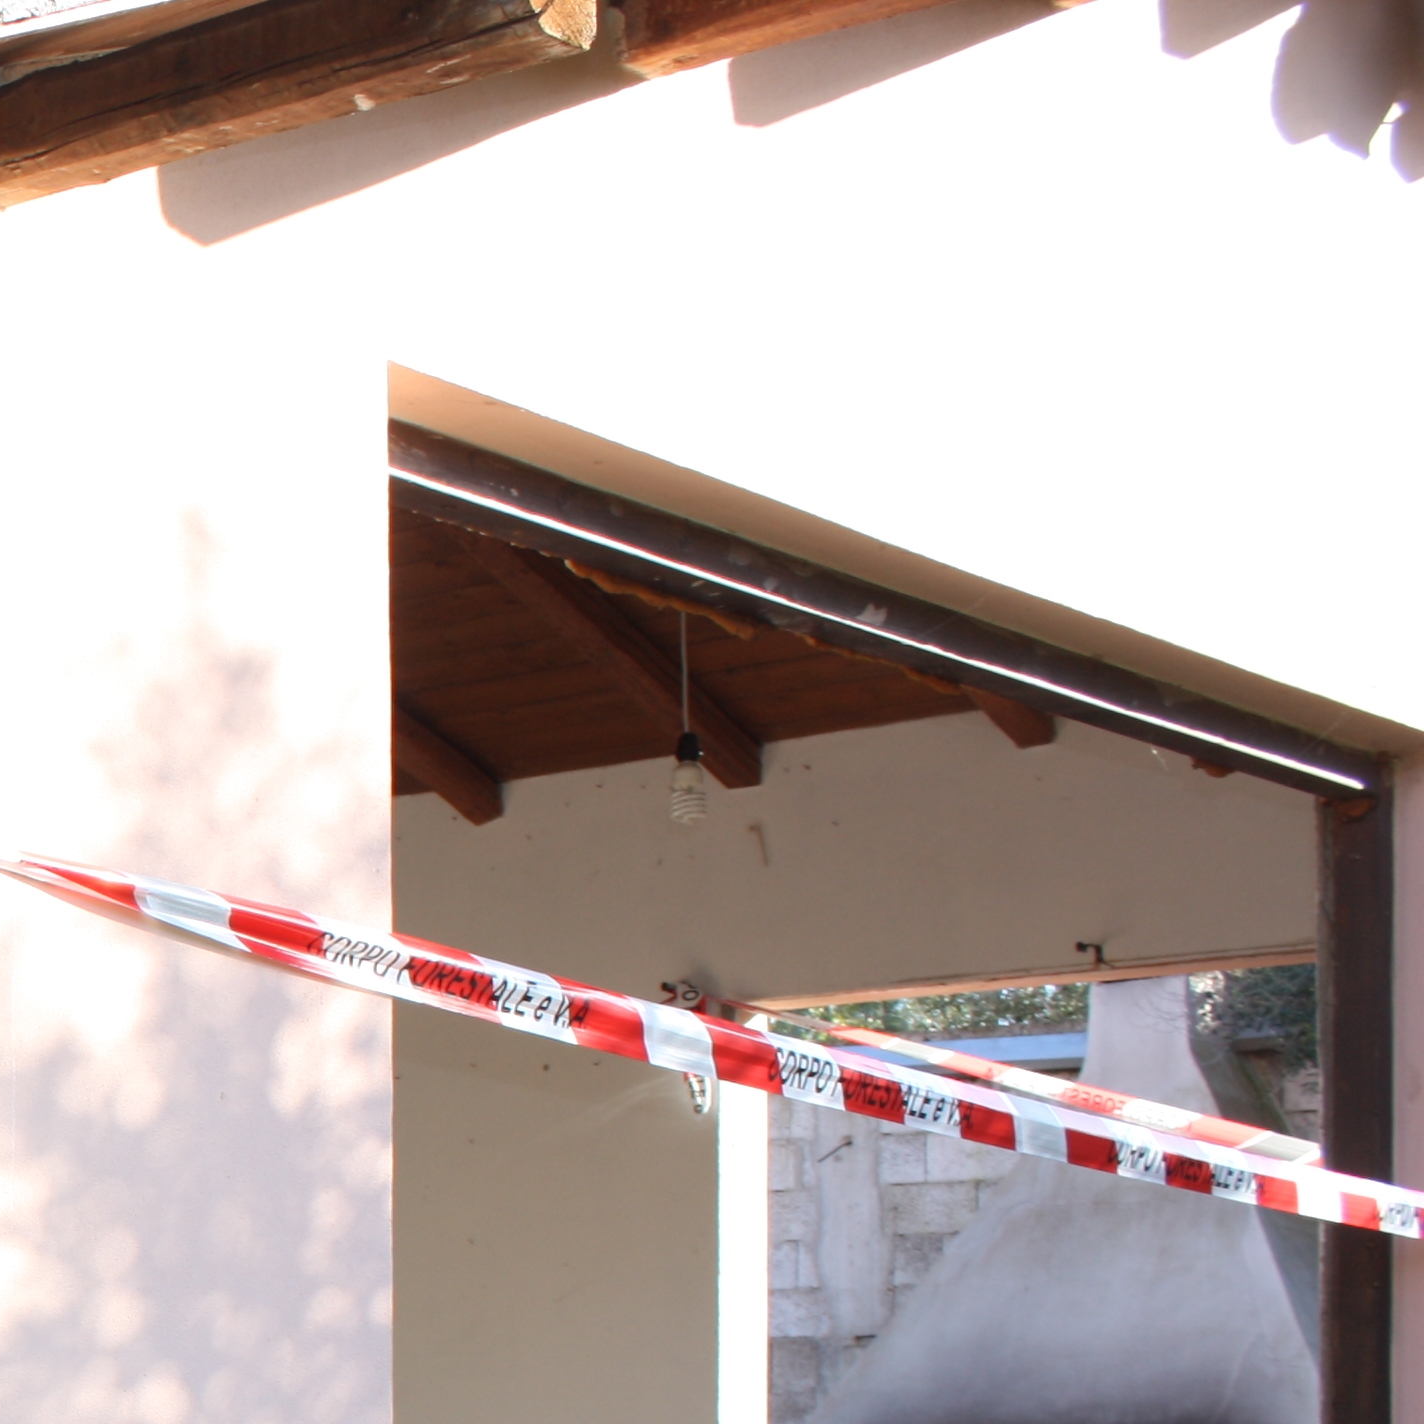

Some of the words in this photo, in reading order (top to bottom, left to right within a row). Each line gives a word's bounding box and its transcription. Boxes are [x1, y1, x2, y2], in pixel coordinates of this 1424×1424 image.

[307, 931, 401, 977] CORPO
[397, 955, 537, 1018] FORESTALE
[768, 1046, 834, 1093] CORPO
[831, 1070, 934, 1120] FORESTALE
